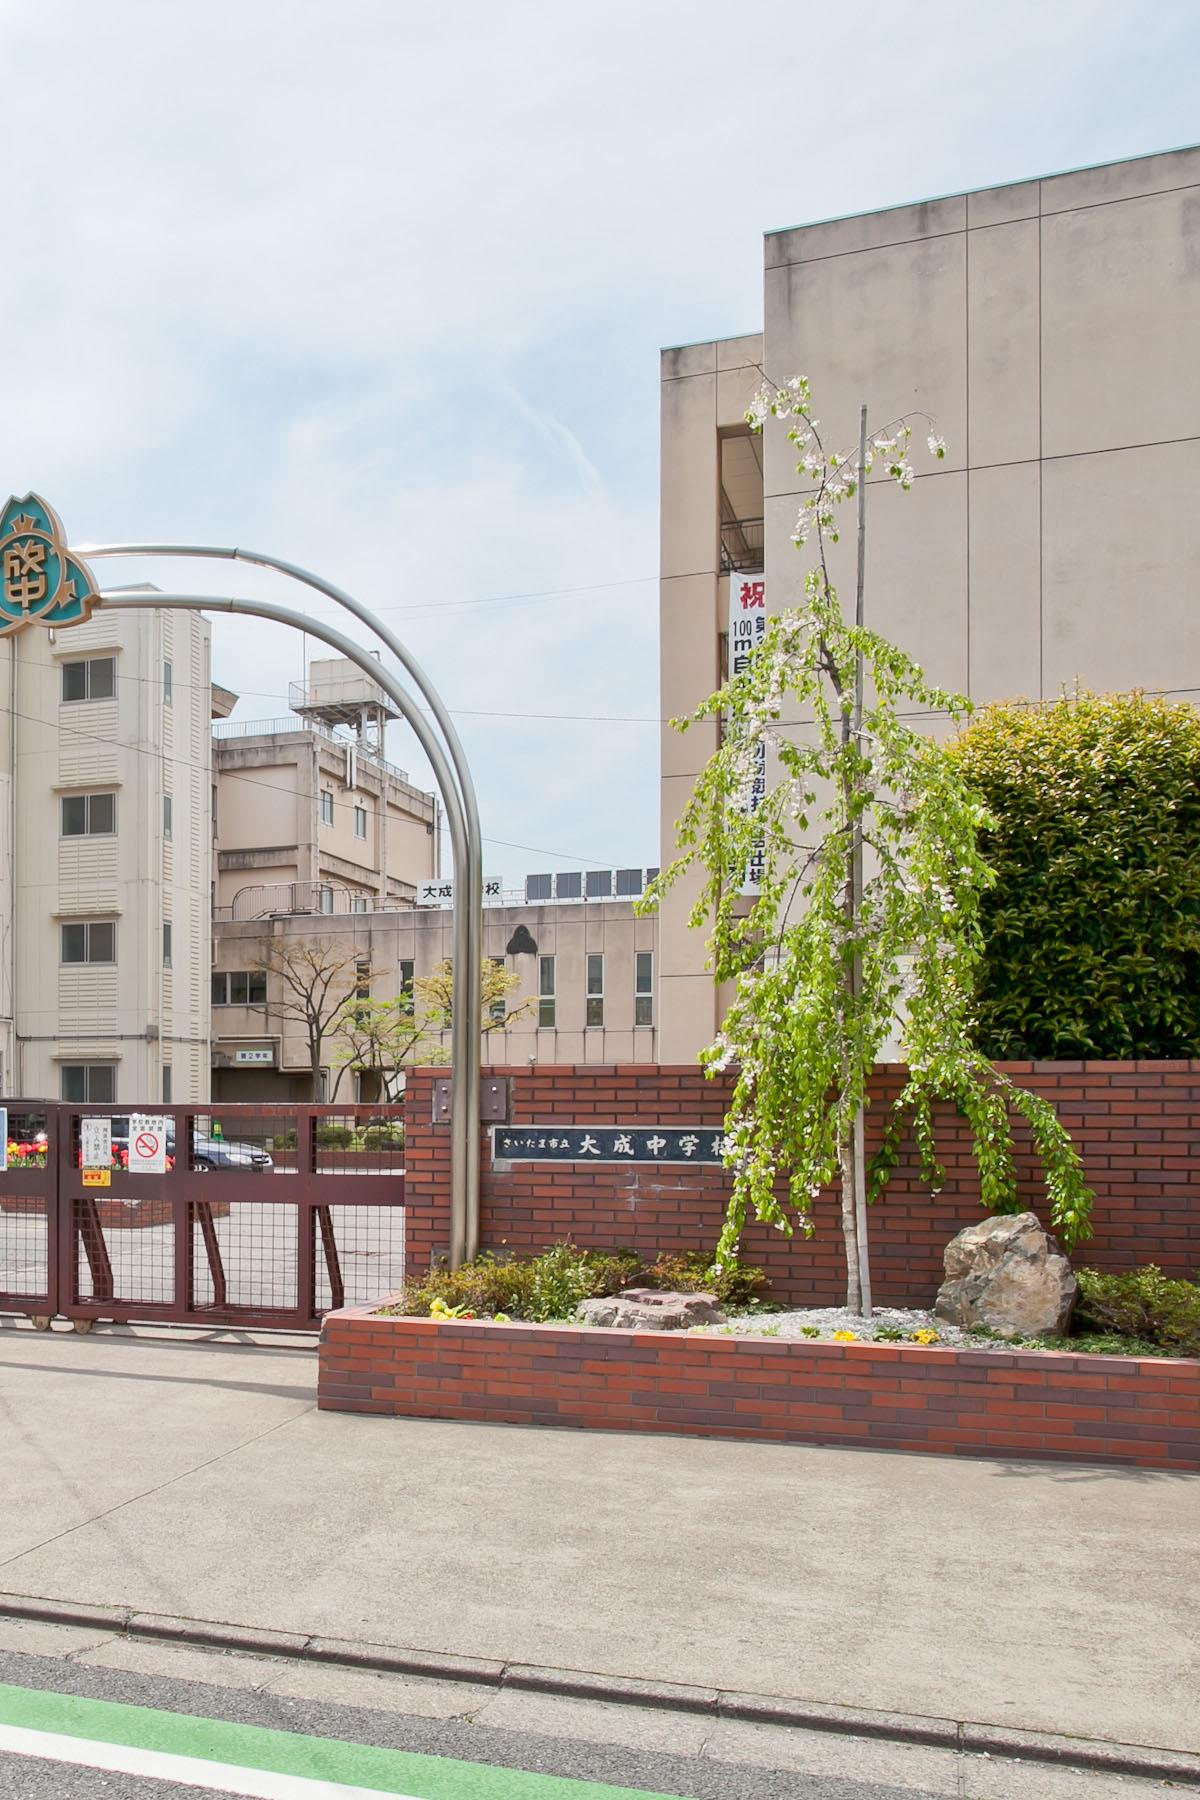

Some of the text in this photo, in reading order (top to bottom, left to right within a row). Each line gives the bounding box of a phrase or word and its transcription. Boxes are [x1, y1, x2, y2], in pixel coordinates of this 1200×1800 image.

[740, 581, 765, 609] 祝
[503, 1138, 570, 1149] さいたま市立
